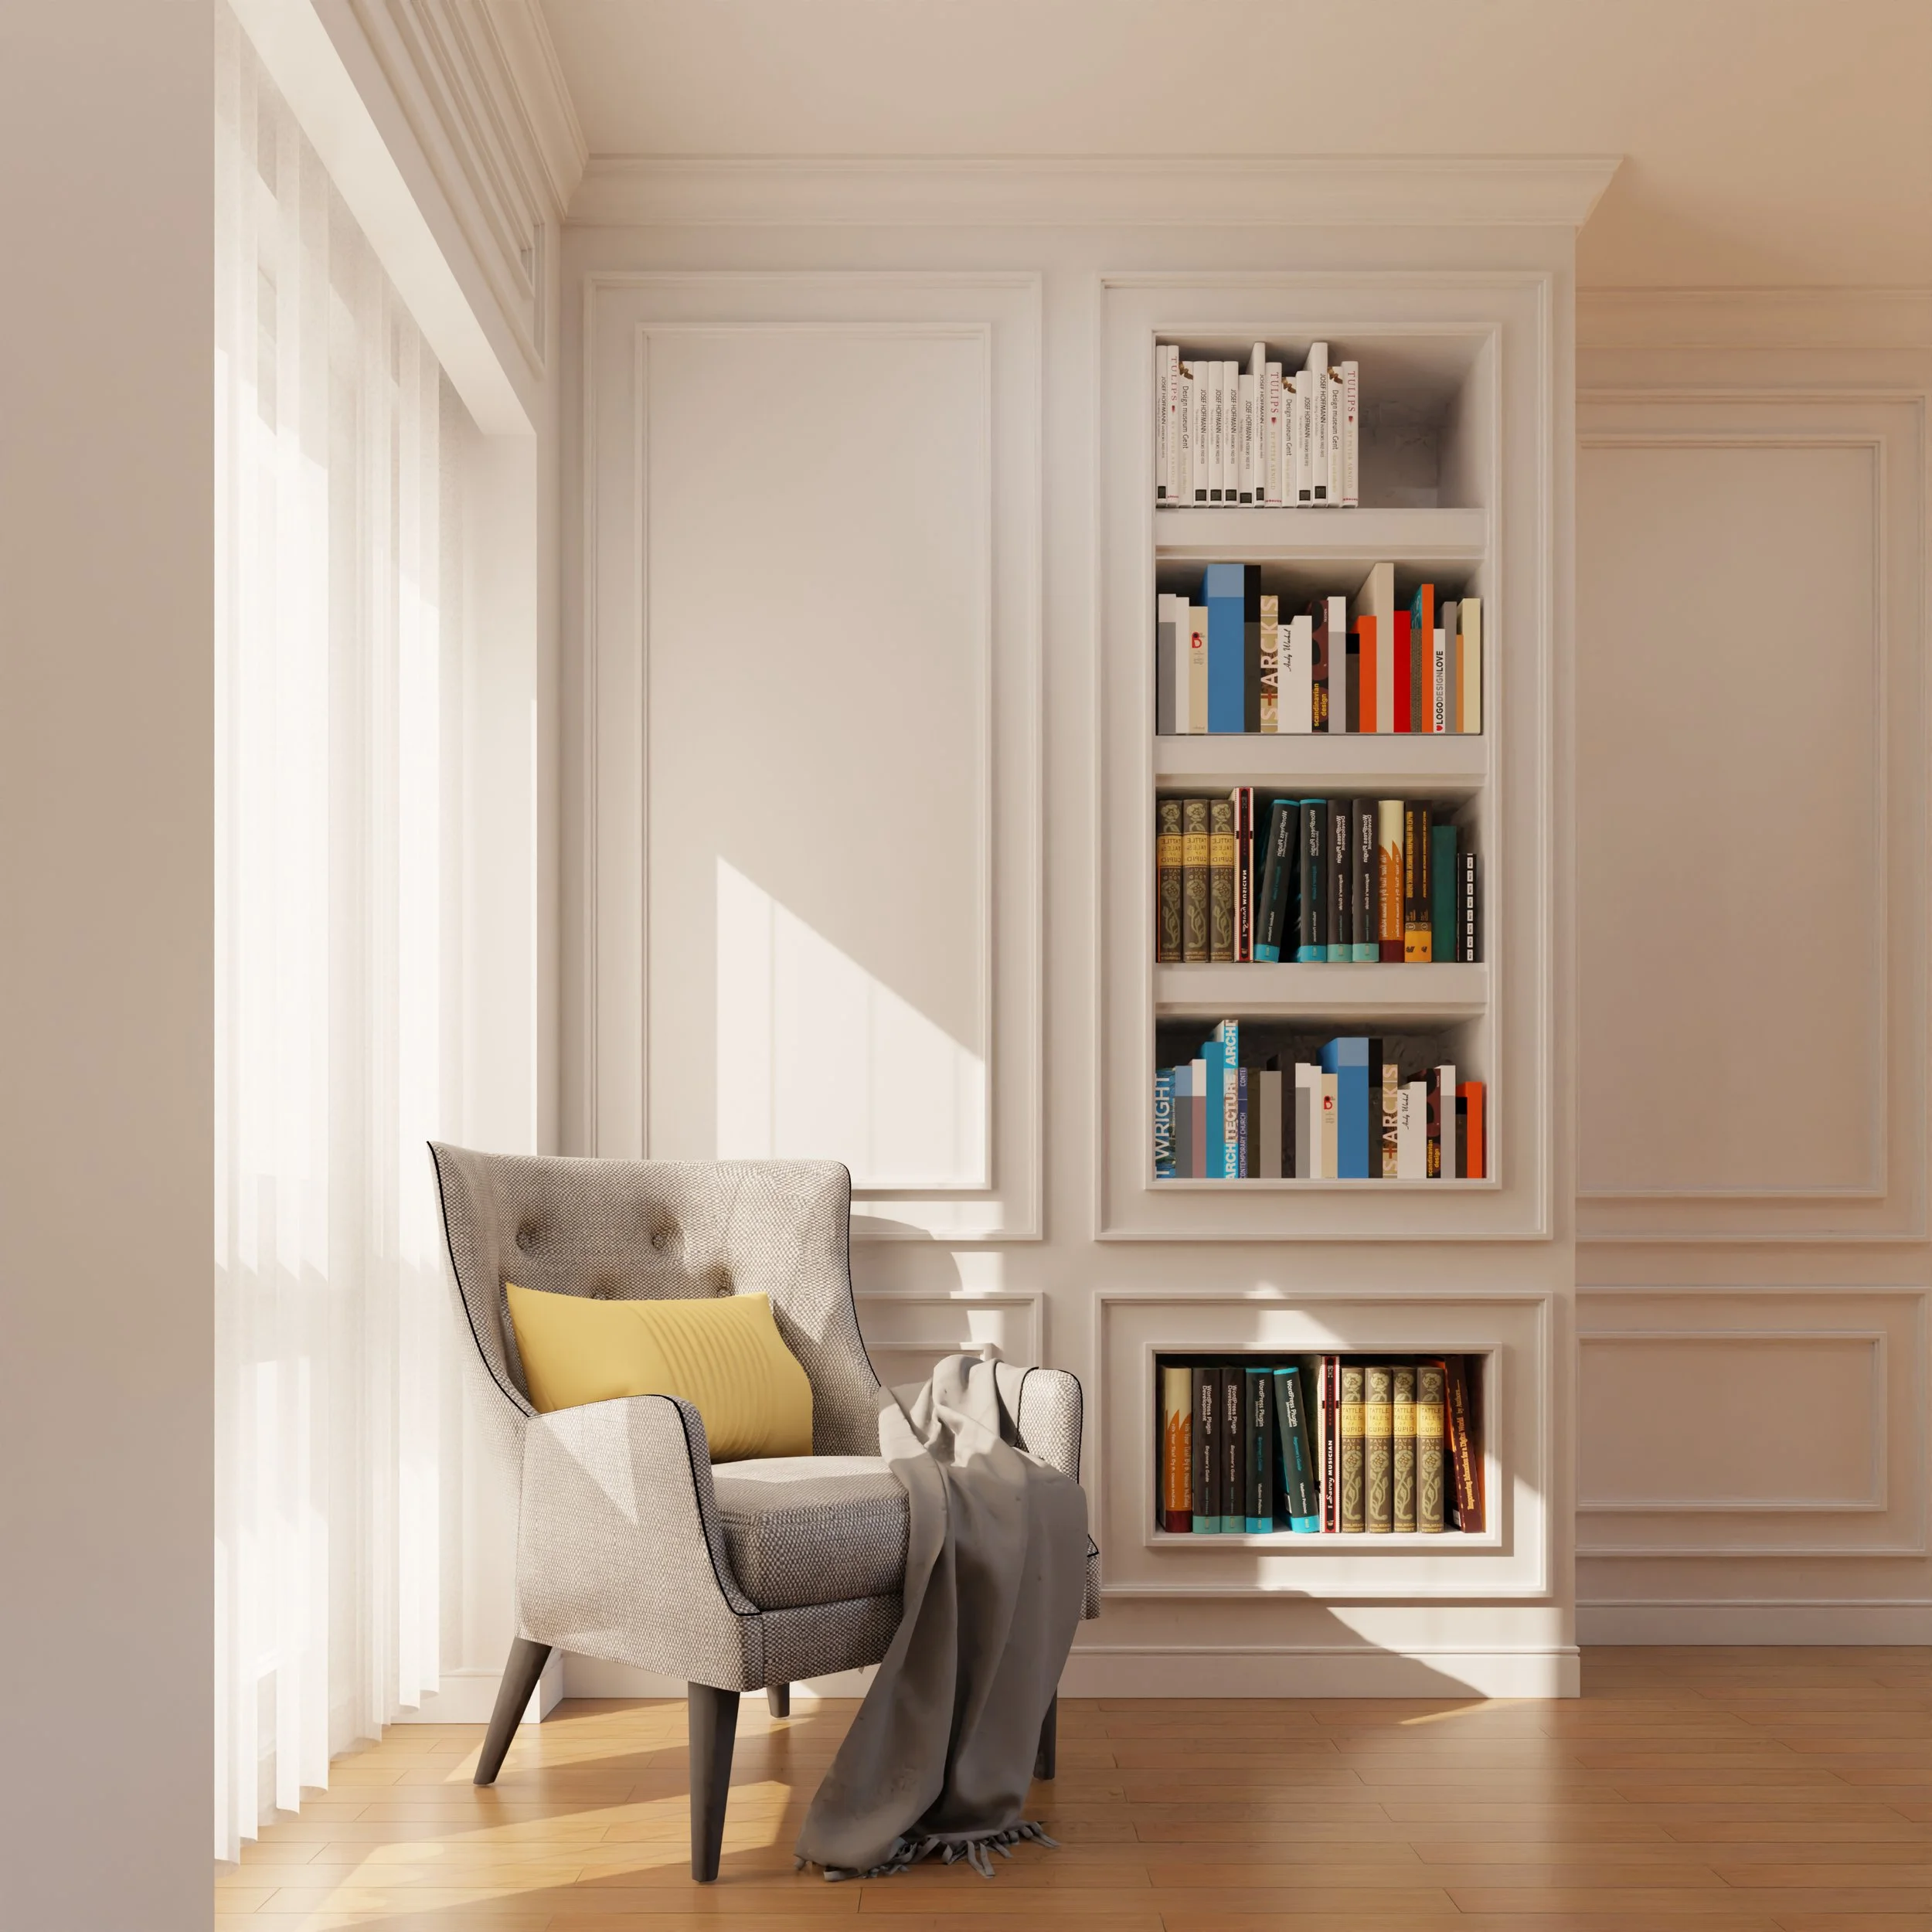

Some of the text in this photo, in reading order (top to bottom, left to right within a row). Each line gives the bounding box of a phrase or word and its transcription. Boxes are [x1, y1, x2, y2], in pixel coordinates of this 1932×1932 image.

[1270, 372, 1279, 413] TULIPS
[1284, 655, 1292, 672] Andy
[1155, 1073, 1169, 1160] WRIGHT
[1226, 1075, 1236, 1179] ARCHITECTURE
[1287, 1380, 1295, 1408] WordPress
[1459, 1433, 1468, 1447] Digital
[1465, 1481, 1475, 1509] Empowering
